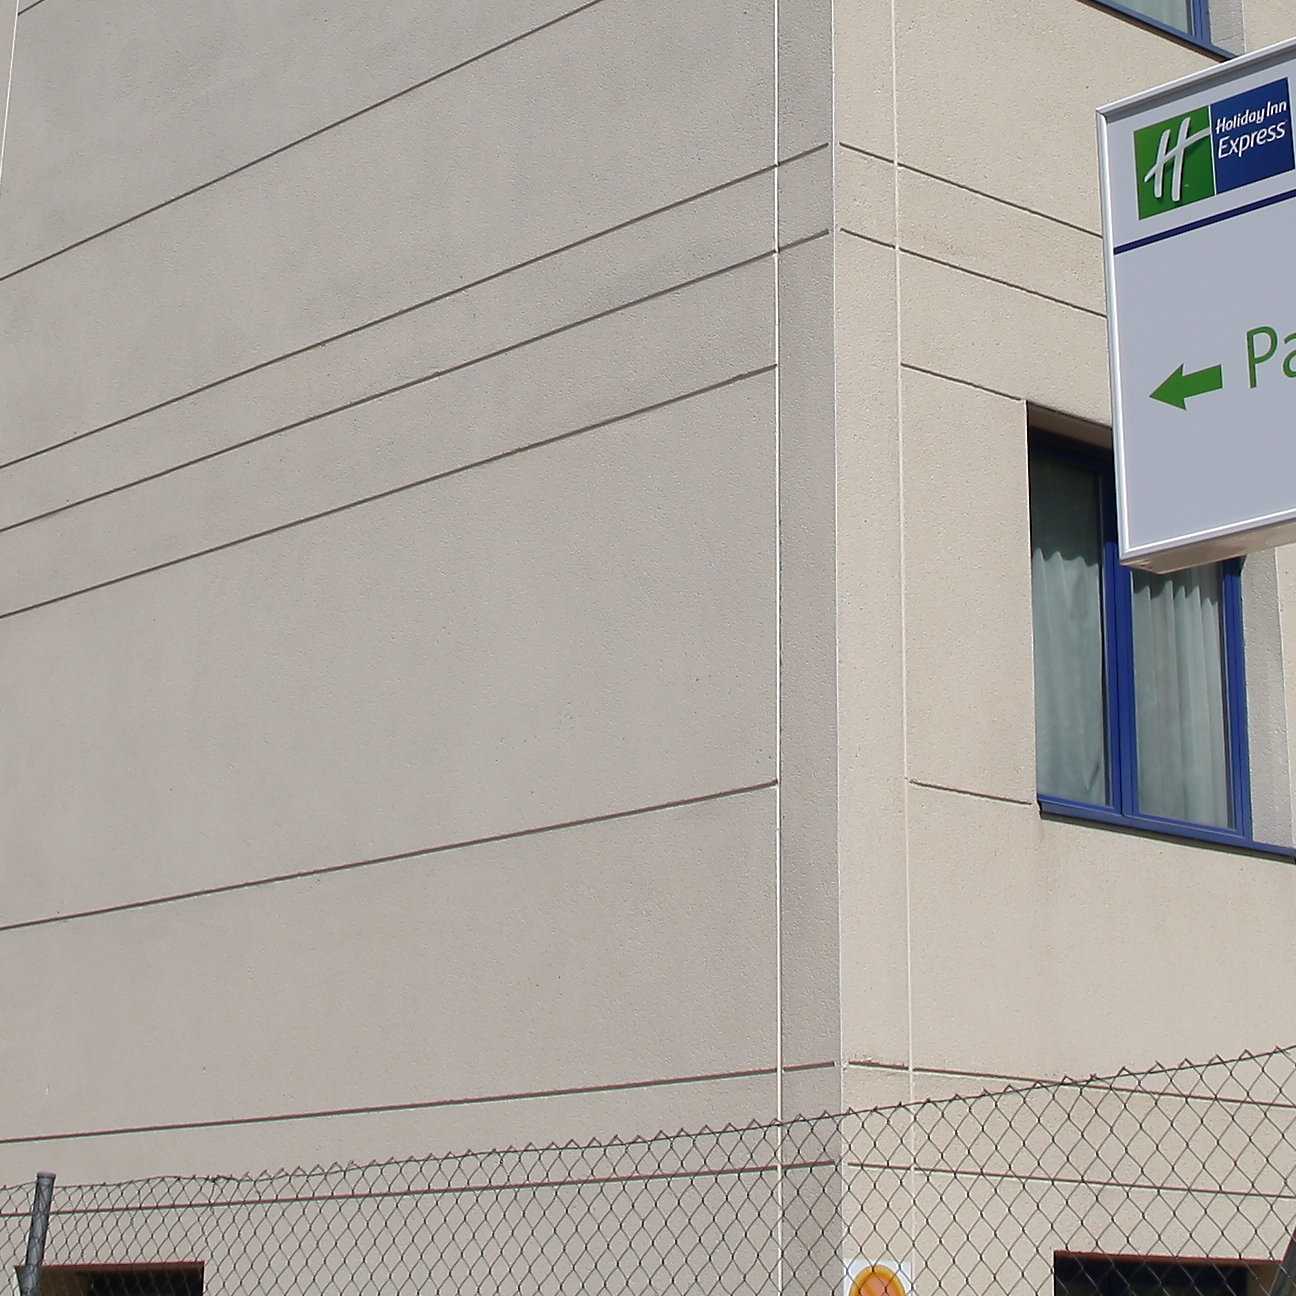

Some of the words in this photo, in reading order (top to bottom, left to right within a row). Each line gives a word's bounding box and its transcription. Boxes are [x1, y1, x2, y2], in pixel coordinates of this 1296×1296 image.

[1215, 108, 1265, 135] Holiday
[1266, 100, 1287, 117] Inn
[1218, 121, 1286, 159] Express
